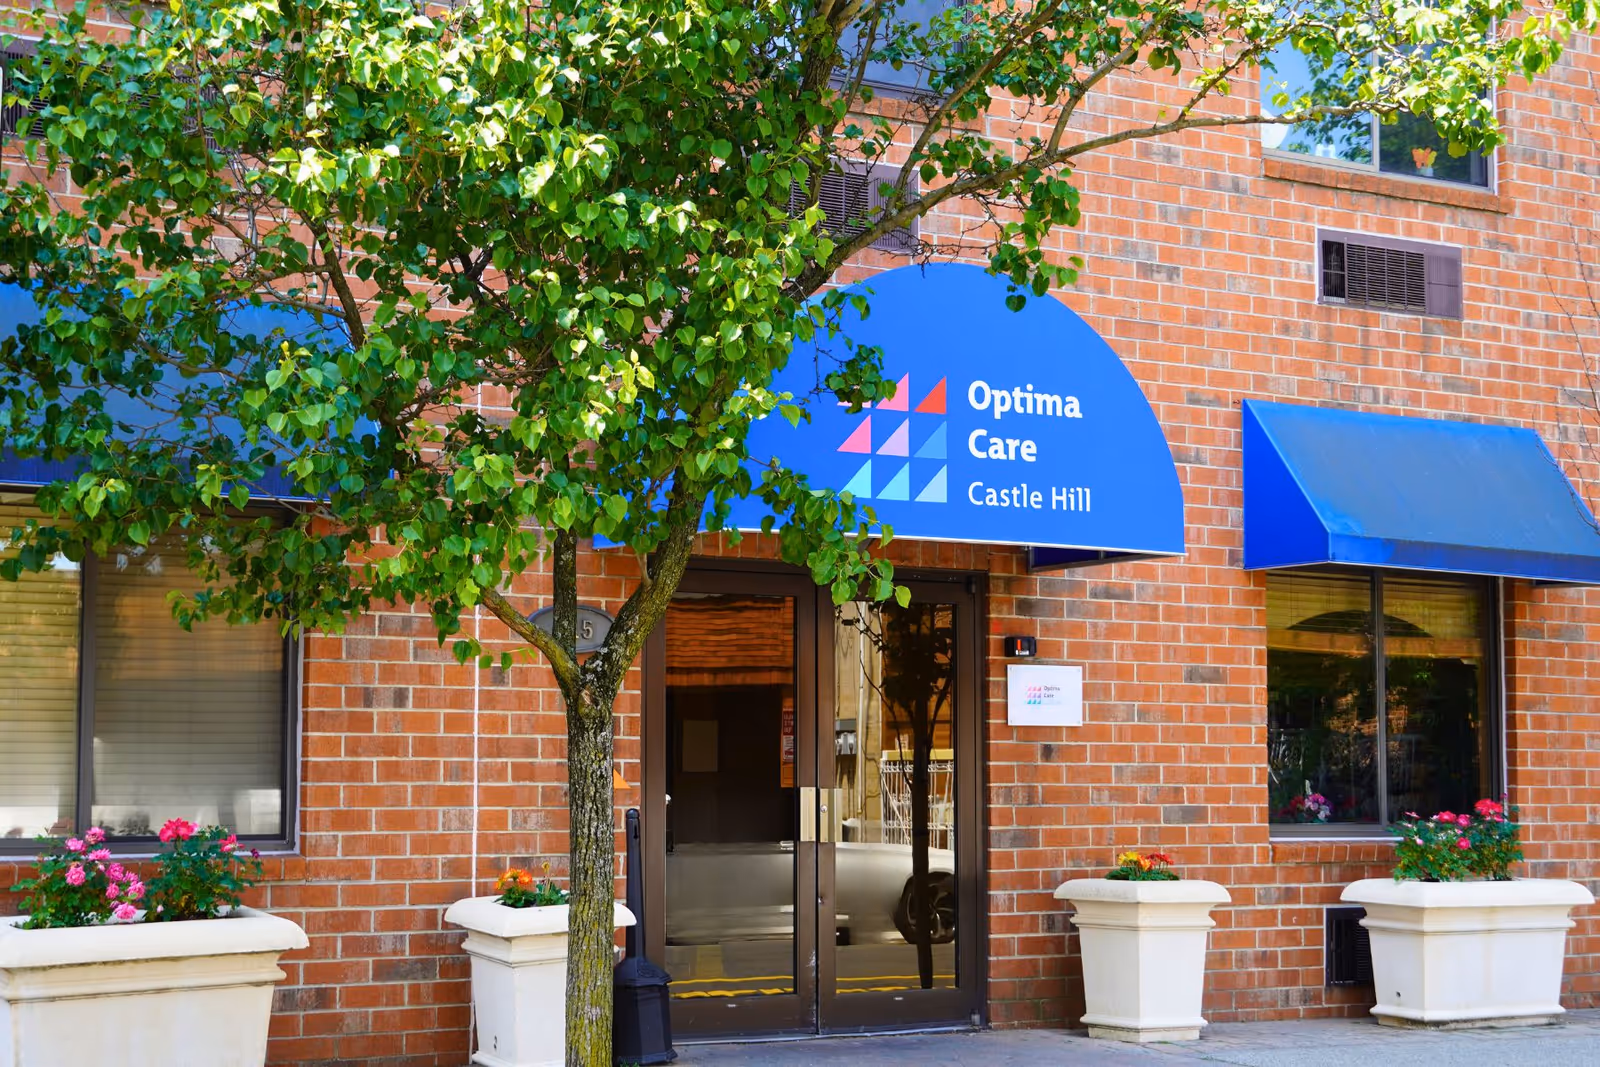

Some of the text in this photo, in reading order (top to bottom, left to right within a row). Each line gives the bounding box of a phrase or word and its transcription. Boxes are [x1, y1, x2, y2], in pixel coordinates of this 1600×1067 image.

[967, 380, 1083, 420] Optima
[968, 428, 1038, 462] Care
[968, 481, 1091, 512] Castle Hill
